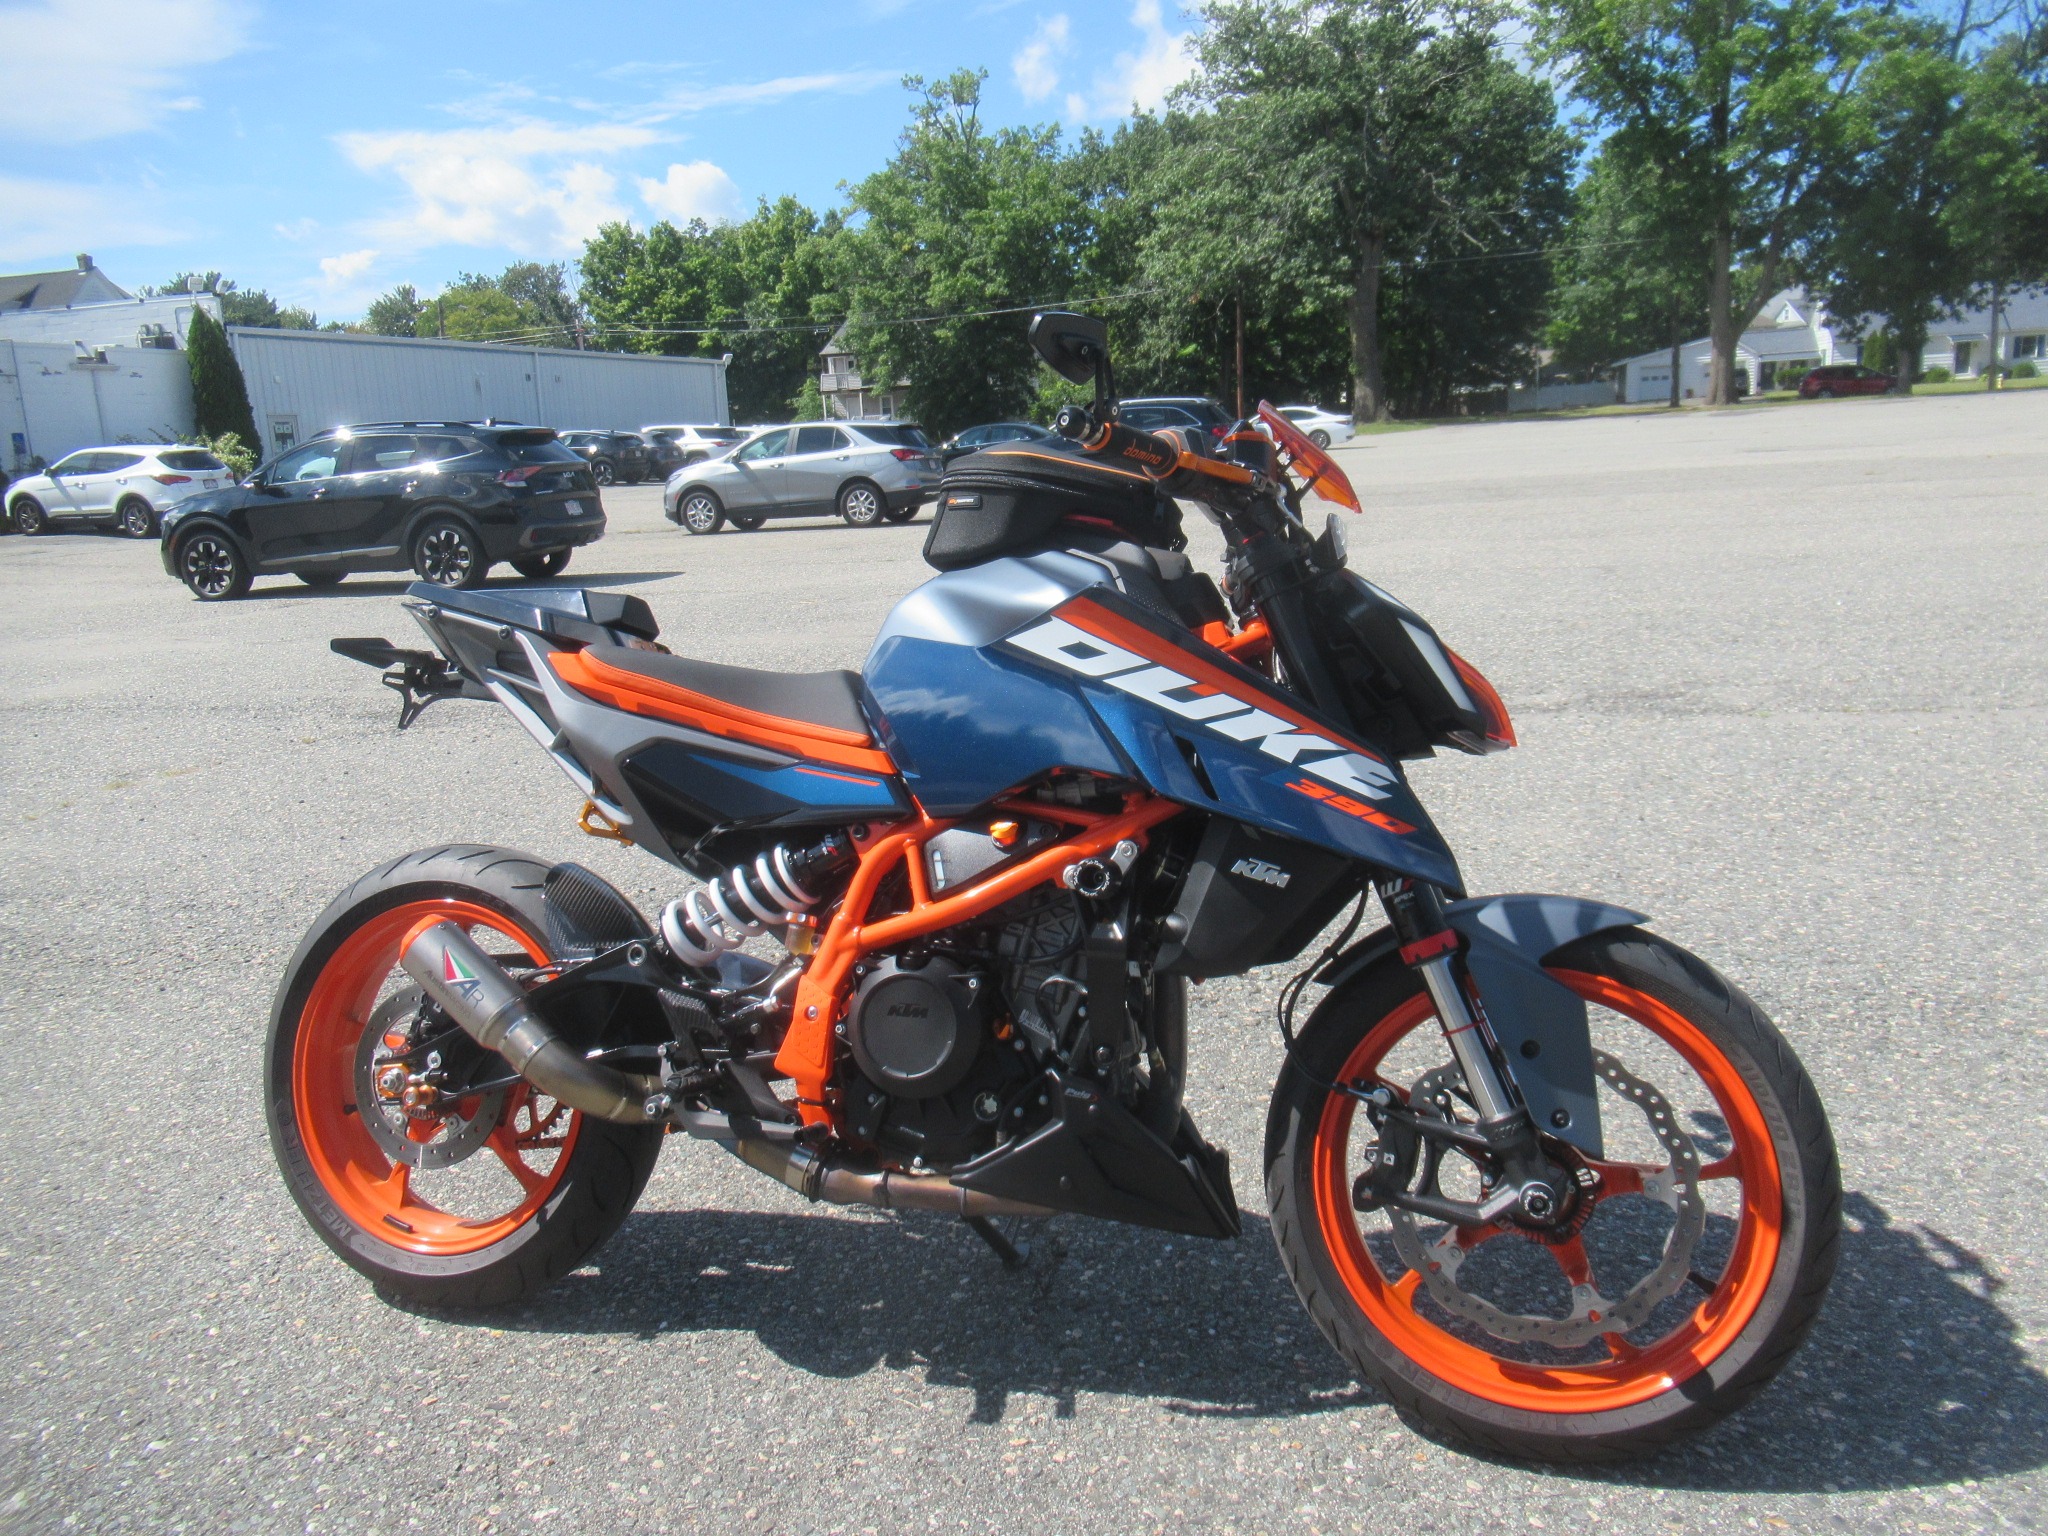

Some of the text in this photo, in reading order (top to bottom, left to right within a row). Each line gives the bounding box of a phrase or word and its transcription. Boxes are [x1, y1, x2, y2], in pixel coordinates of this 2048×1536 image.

[1006, 615, 1399, 800] DUKE
[1285, 778, 1418, 835] 390
[1230, 858, 1292, 888] KTM
[886, 1002, 930, 1019] KTM
[281, 1130, 352, 1238] METZELER
